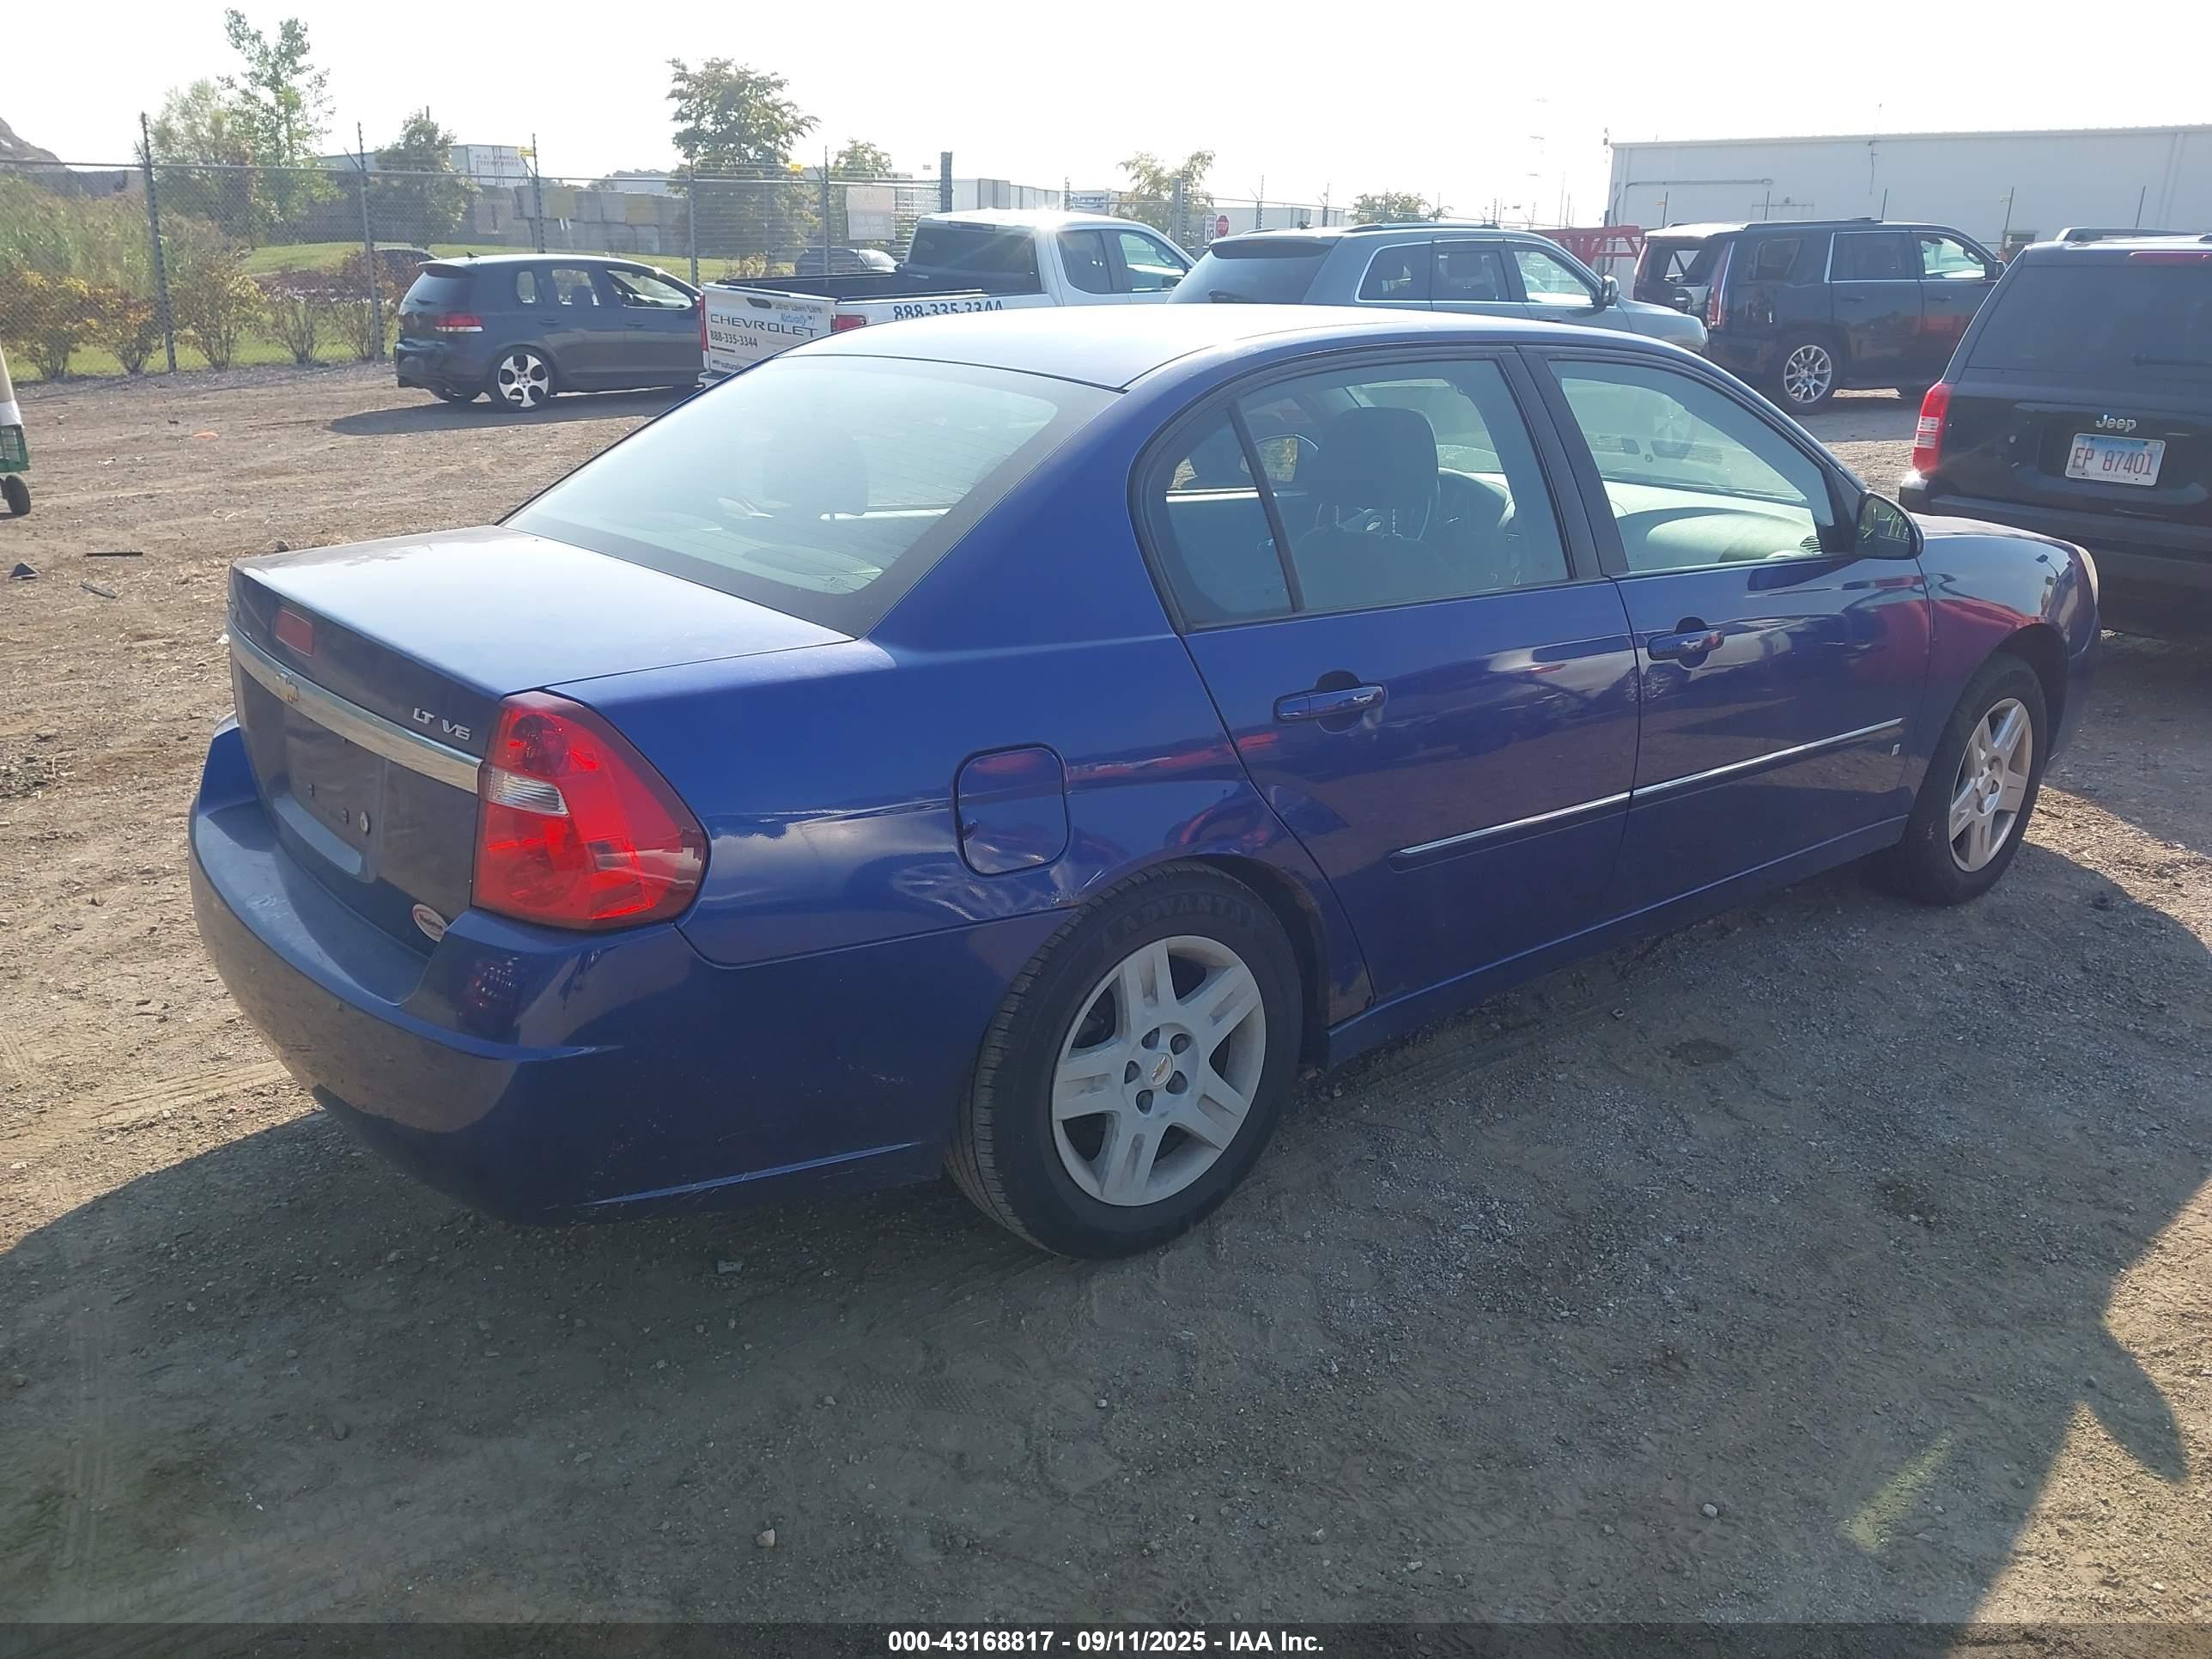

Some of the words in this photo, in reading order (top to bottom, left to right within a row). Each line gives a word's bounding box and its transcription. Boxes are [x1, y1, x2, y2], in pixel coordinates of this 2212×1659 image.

[710, 314, 818, 337] CHEVROLET
[709, 330, 758, 349] 888-335-3344
[2095, 414, 2137, 433] Jeep
[2072, 447, 2095, 470] EP
[2102, 449, 2154, 476] 87401
[413, 708, 435, 725] LT
[441, 719, 471, 741] V6
